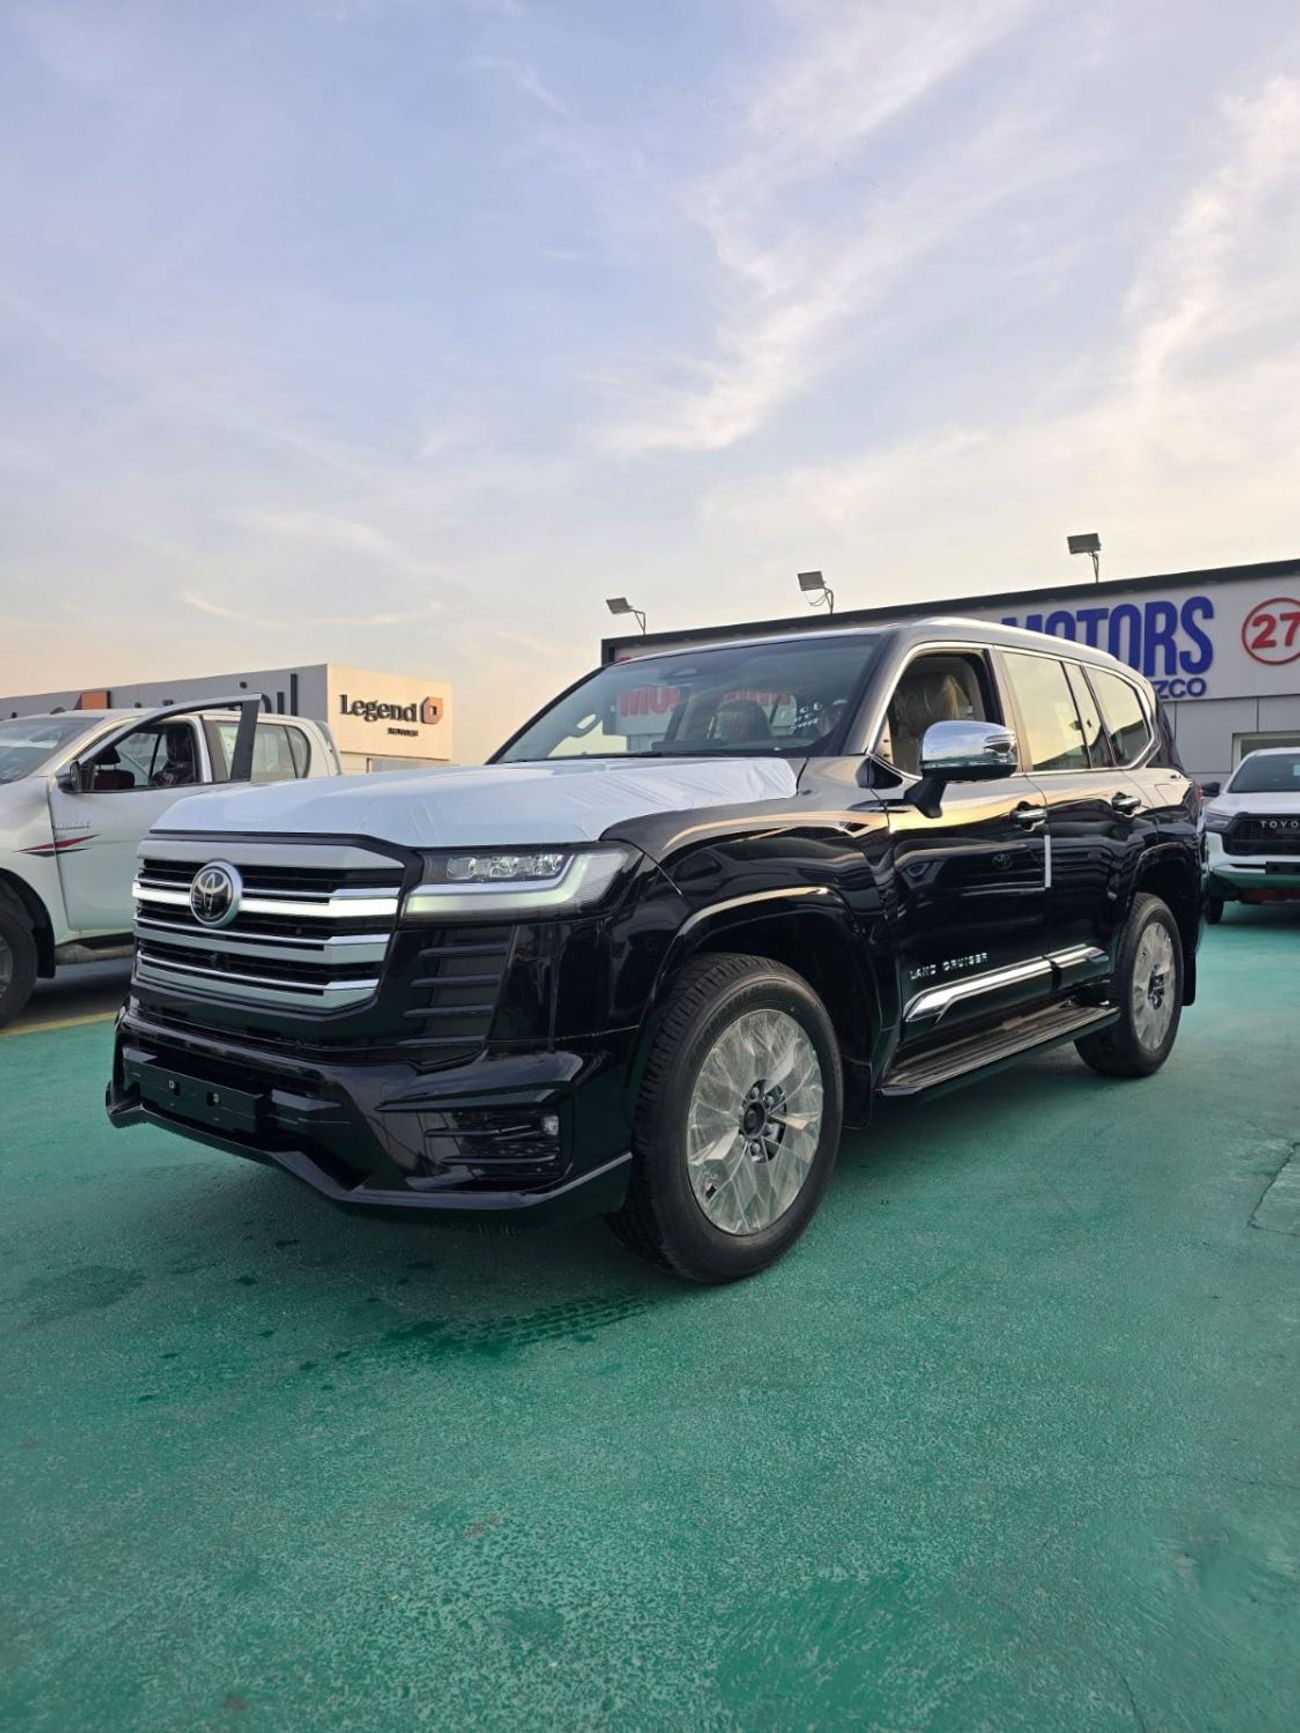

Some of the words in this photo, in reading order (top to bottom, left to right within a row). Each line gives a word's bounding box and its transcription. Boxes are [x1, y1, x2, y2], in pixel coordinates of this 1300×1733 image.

[1001, 596, 1214, 678] TORS
[1251, 612, 1300, 649] 27
[339, 694, 417, 722] Legend
